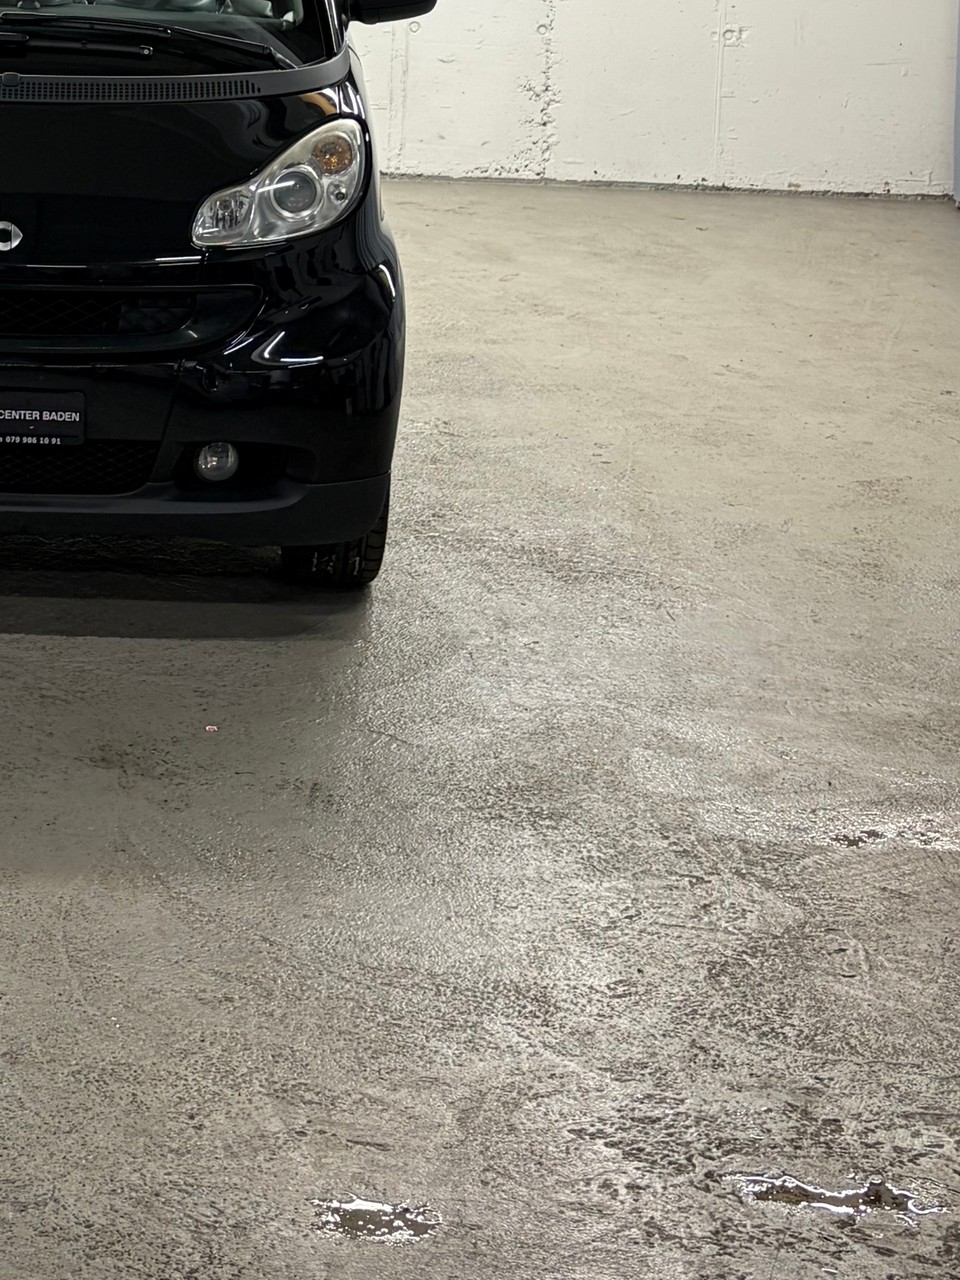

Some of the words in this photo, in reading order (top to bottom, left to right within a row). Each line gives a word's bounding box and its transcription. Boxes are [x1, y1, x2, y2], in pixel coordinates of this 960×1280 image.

[42, 410, 81, 422] BADEN
[5, 435, 21, 444] 079
[39, 436, 50, 445] 10
[50, 437, 61, 445] 91
